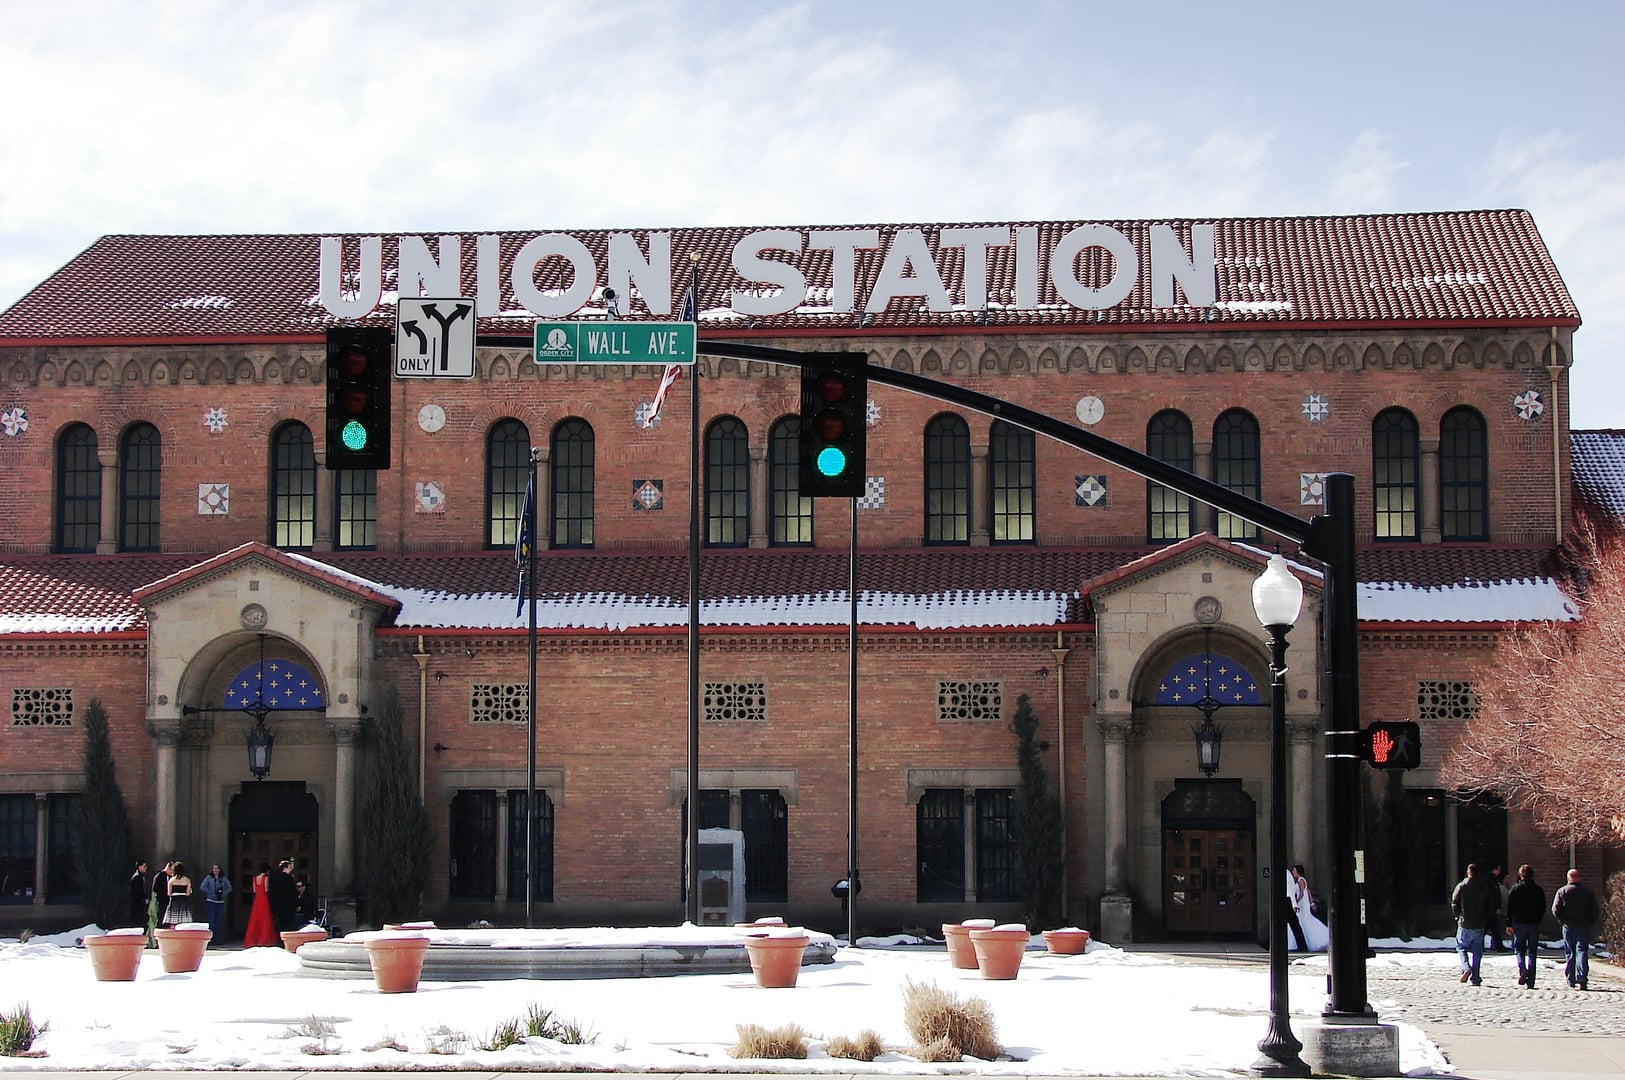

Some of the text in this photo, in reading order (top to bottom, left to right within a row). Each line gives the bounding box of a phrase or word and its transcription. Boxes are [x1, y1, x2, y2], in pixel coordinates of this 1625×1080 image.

[319, 224, 1215, 319] UNION STATION
[588, 331, 685, 355] WALL AVE.
[400, 358, 430, 371] ONLY
